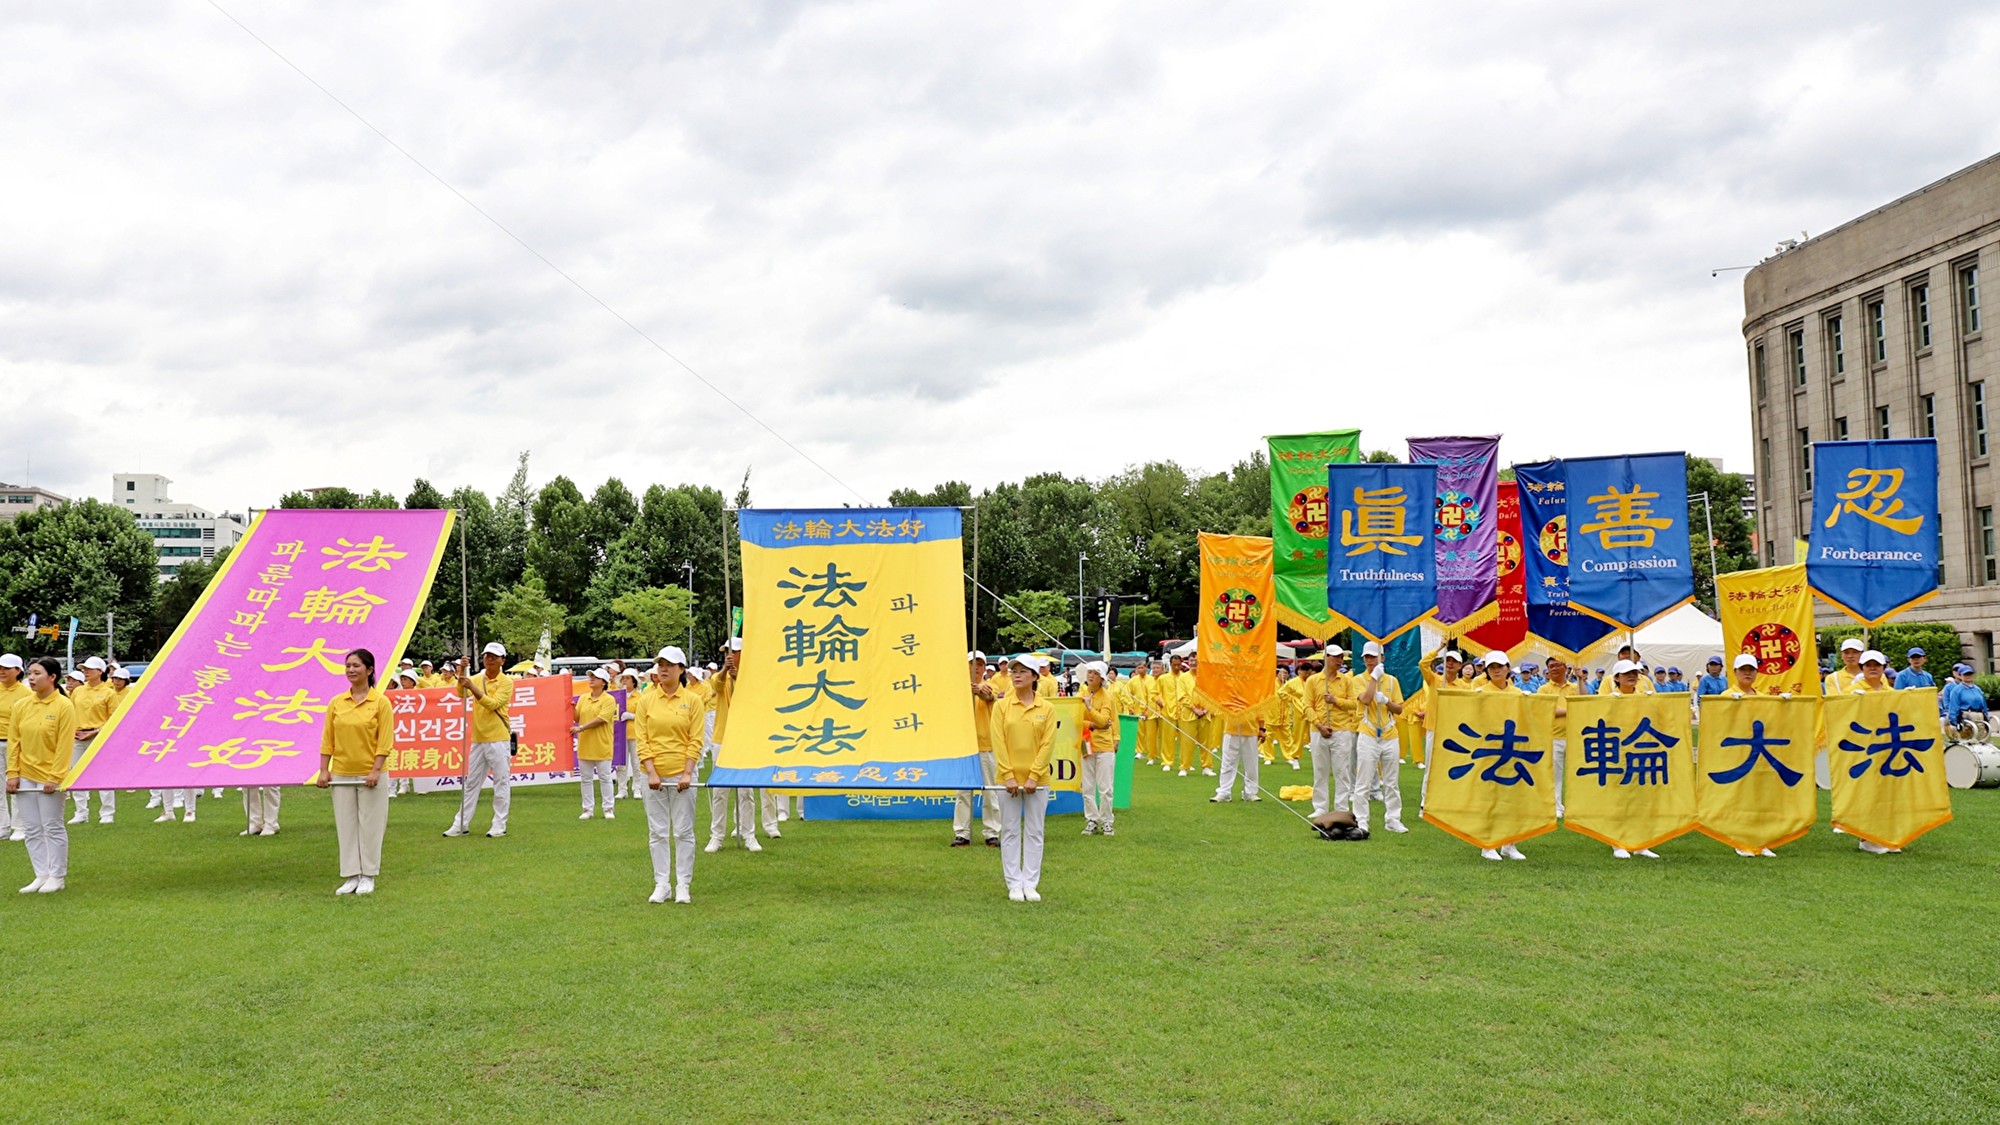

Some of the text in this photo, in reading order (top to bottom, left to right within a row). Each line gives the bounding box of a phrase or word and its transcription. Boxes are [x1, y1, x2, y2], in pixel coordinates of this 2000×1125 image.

[772, 518, 926, 540] 法輪大法好
[1498, 512, 1518, 521] Dafa
[1538, 497, 1566, 505] Falun
[1579, 484, 1674, 550] 善
[1824, 467, 1925, 536] 忍
[1340, 568, 1424, 583] Truthfulness
[1581, 554, 1678, 574] Compassion
[1820, 546, 1923, 562] Forbearance
[1728, 584, 1803, 602] 法輪大法
[1739, 602, 1795, 615] Falun Dafa
[187, 535, 408, 770] 法輪大法好
[768, 561, 869, 755] 法輪大法
[890, 593, 925, 733] 파룬따파
[1442, 719, 1545, 787] 法
[1576, 716, 1680, 786] 輪
[1708, 720, 1804, 787] 大
[1838, 711, 1935, 779] 法
